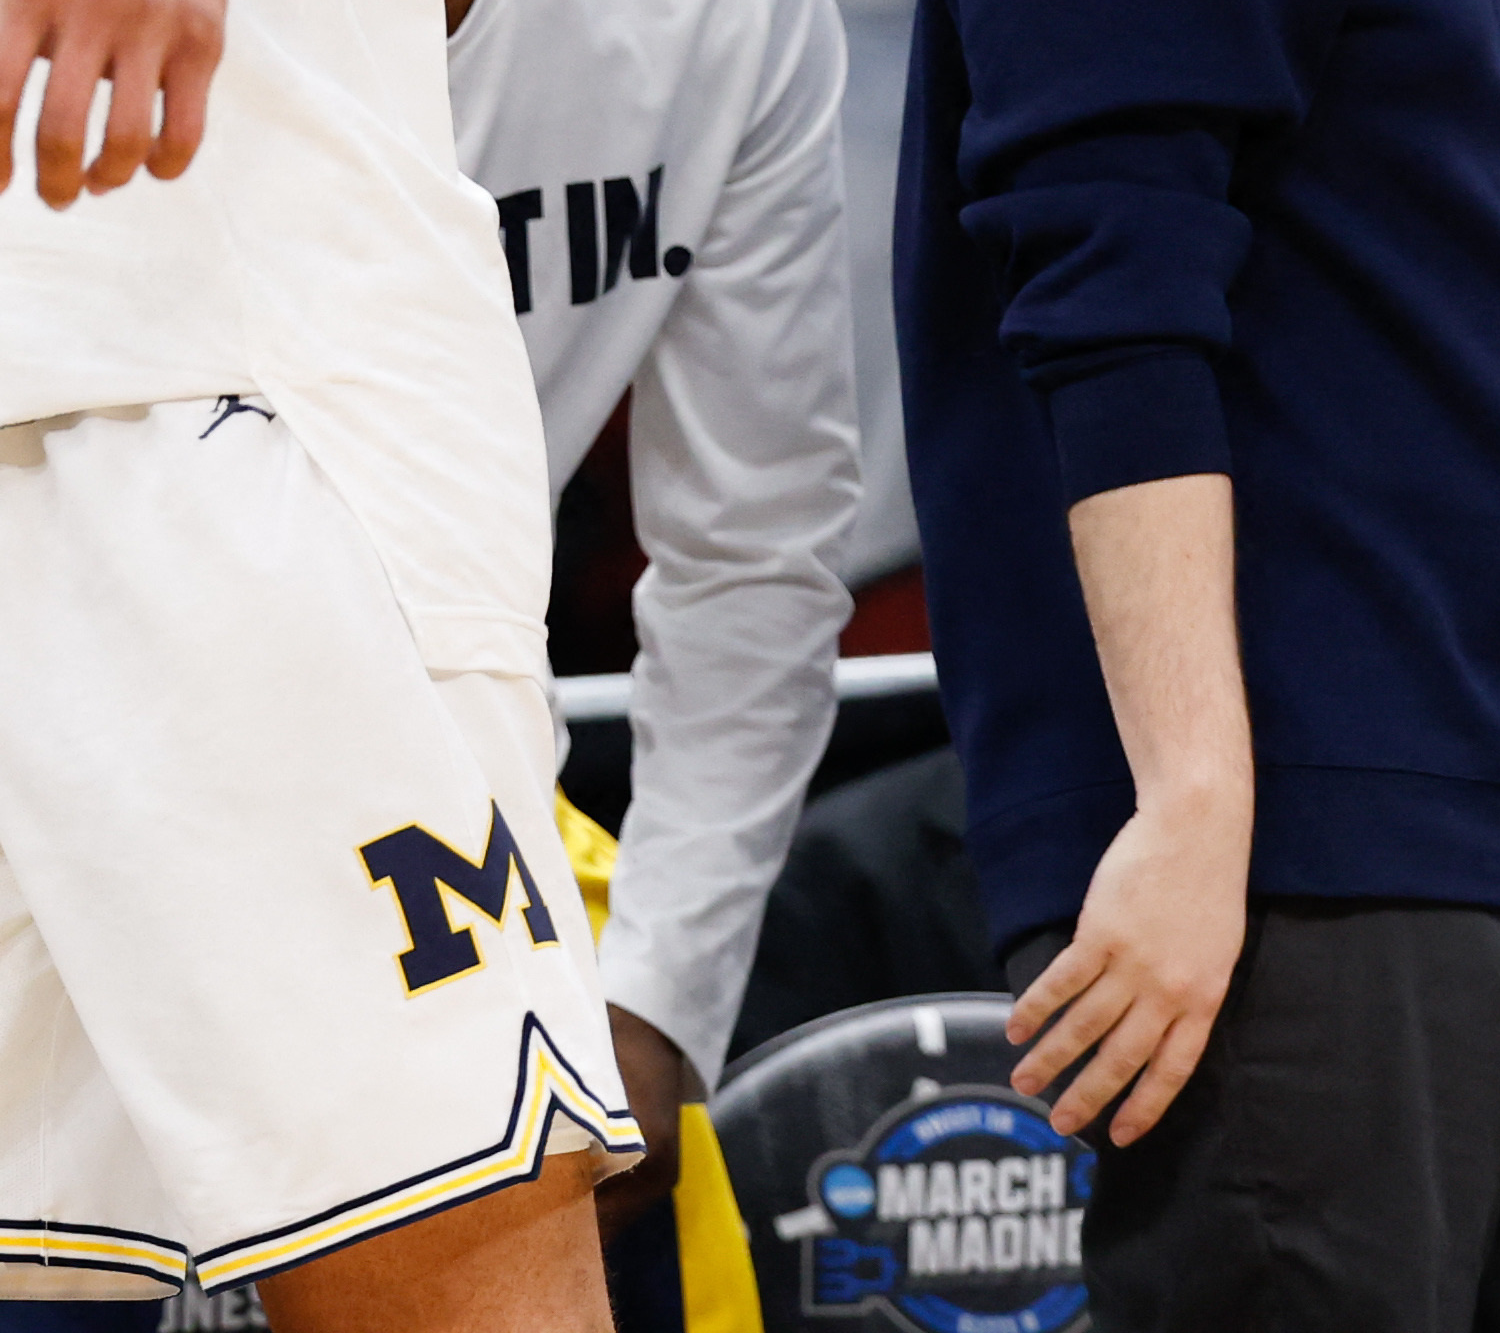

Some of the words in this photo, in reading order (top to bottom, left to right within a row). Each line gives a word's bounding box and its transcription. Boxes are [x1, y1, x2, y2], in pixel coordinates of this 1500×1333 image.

[496, 187, 544, 317] T
[564, 162, 693, 307] IN.
[356, 798, 560, 998] M
[876, 1153, 1067, 1222] MARCH
[907, 1207, 1085, 1277] MADNE
